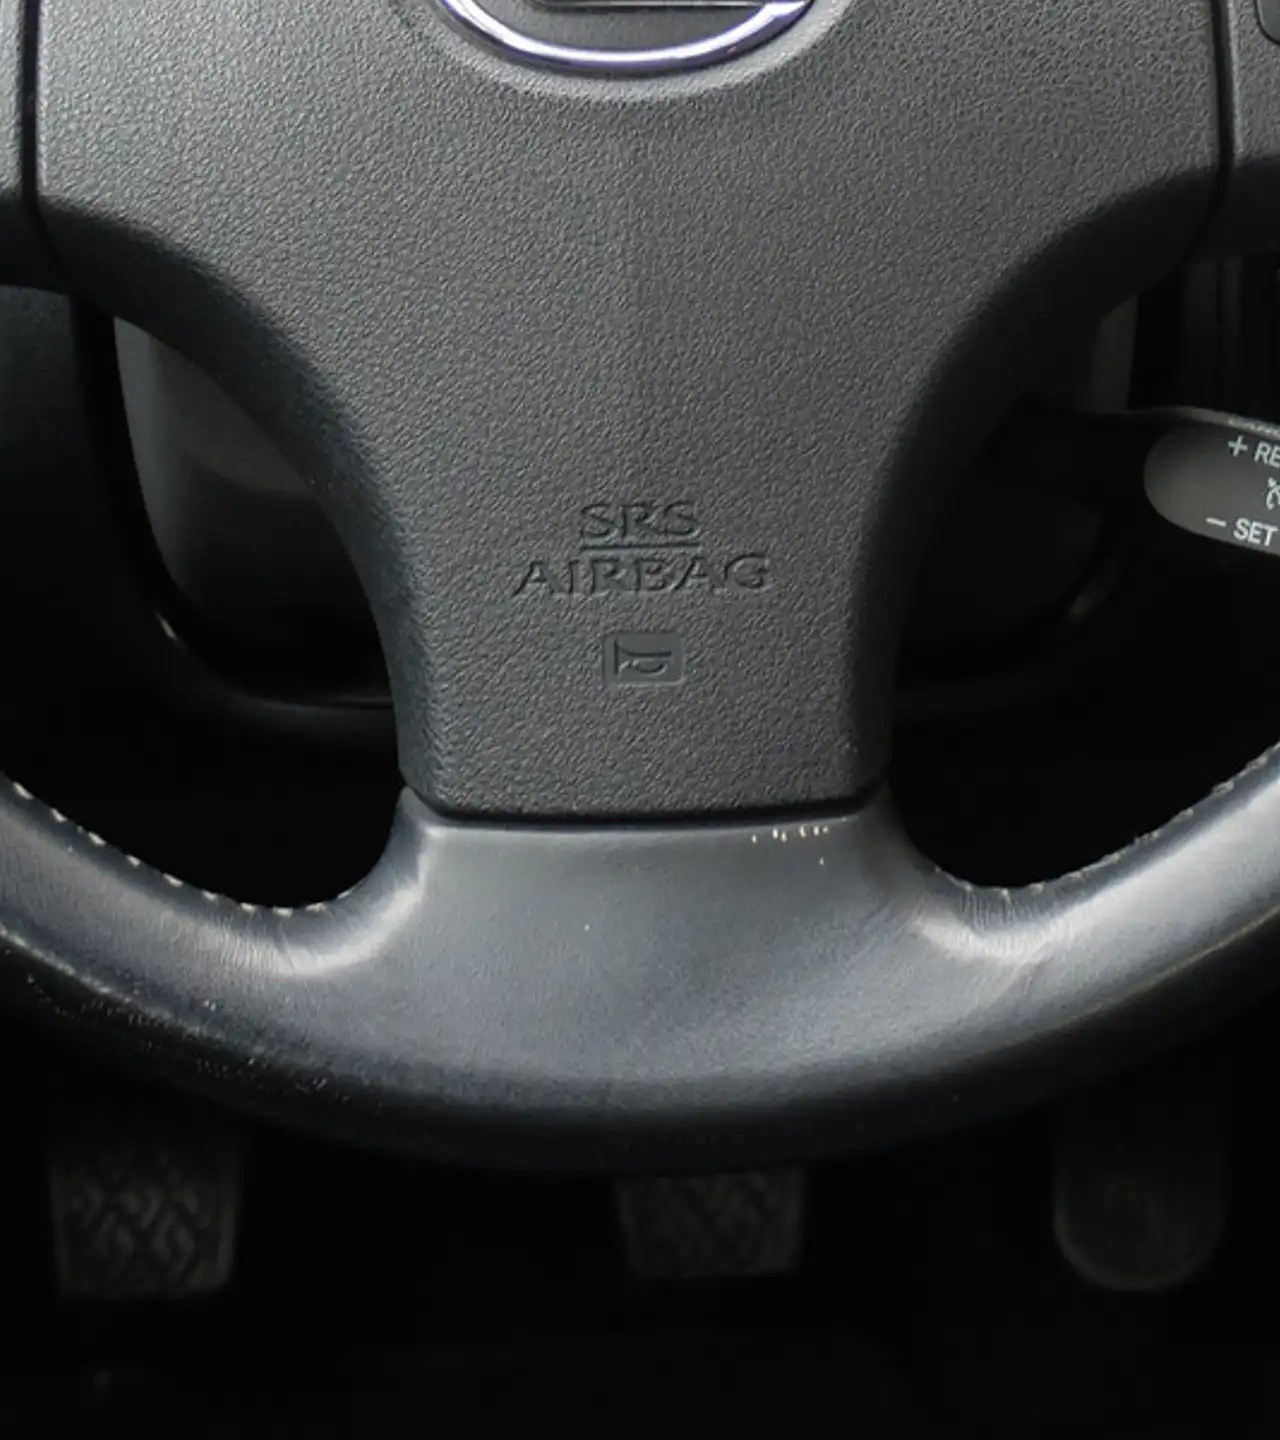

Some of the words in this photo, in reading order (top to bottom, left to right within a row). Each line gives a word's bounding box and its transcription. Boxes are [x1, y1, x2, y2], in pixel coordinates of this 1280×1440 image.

[580, 502, 700, 539] SRS
[1233, 517, 1279, 547] SET
[511, 553, 769, 596] AIRBAG
